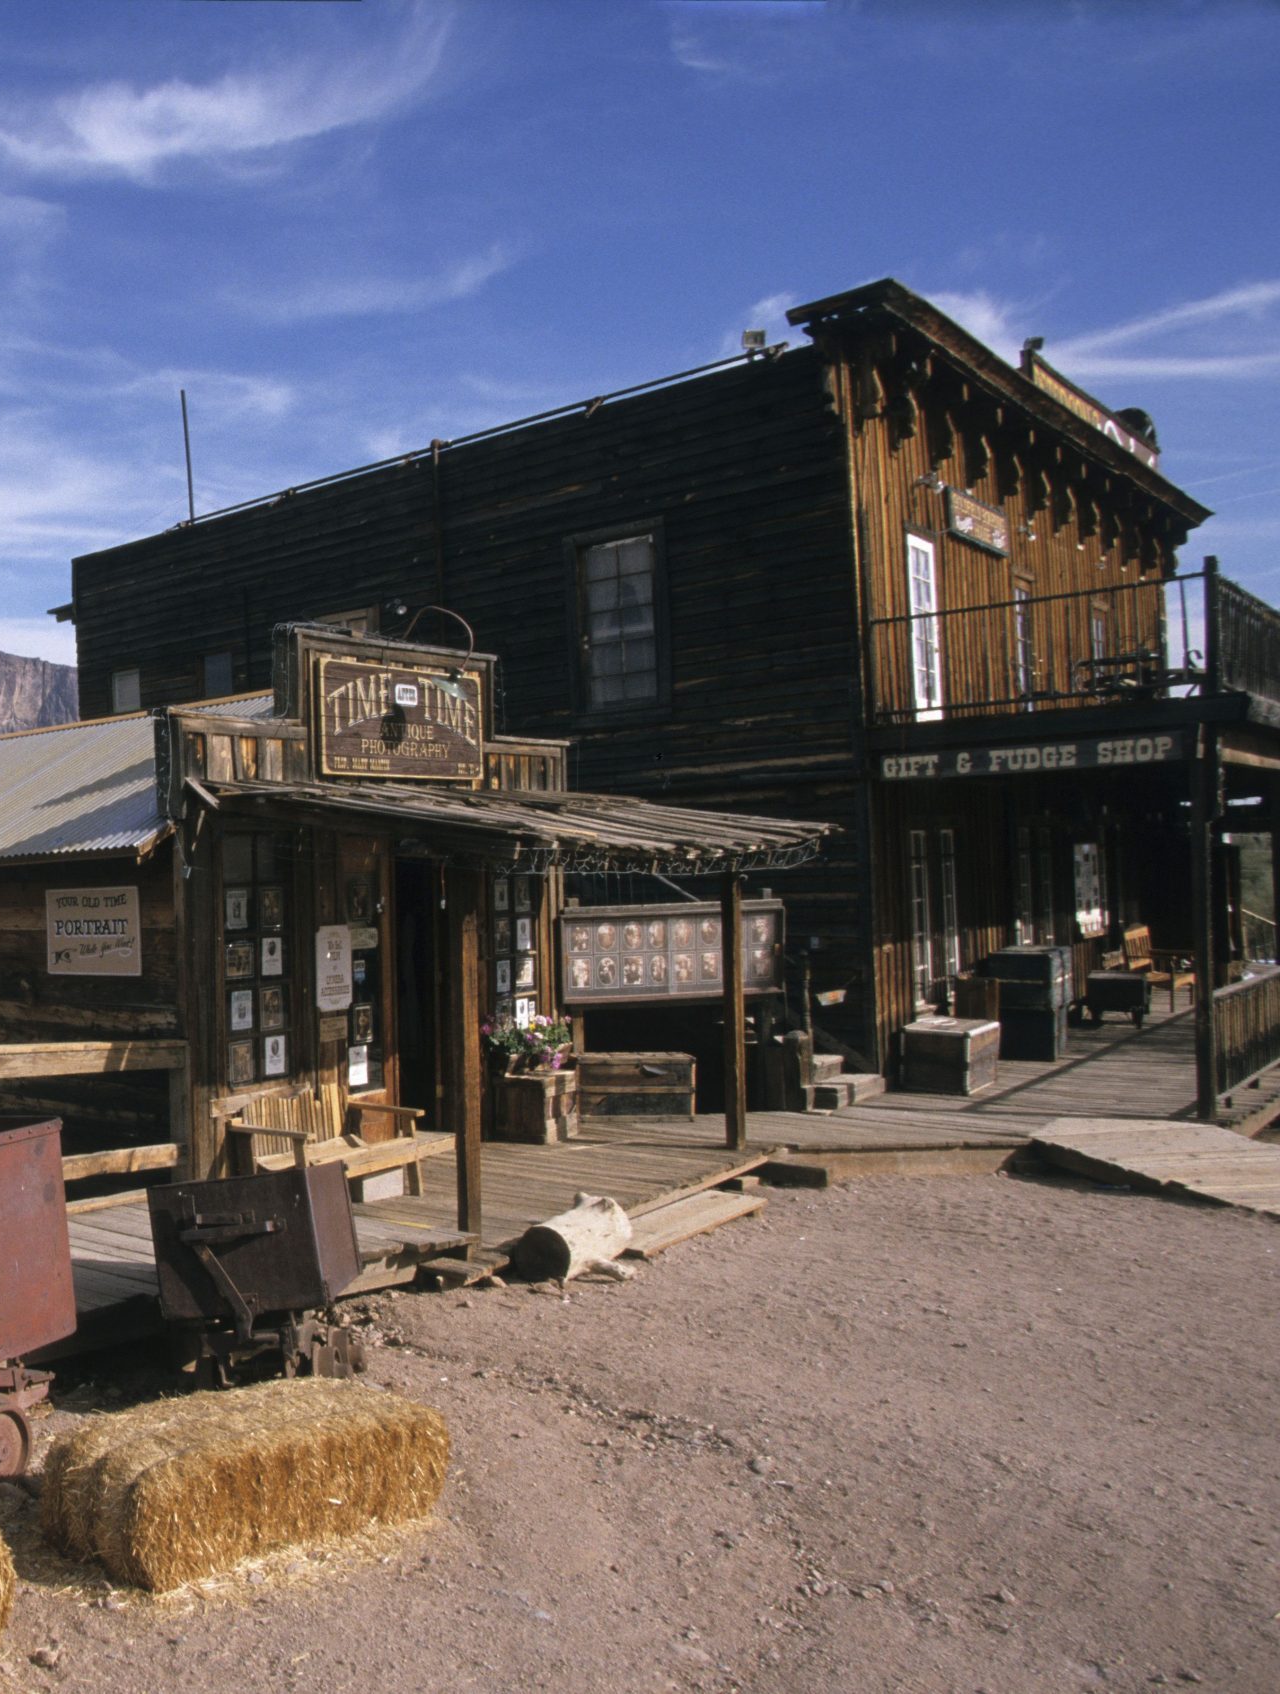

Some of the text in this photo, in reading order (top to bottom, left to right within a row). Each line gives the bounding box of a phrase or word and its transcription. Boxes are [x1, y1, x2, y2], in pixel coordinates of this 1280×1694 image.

[326, 672, 392, 736] TIME
[418, 676, 477, 746] TIME
[380, 722, 434, 741] ANTIQUE
[361, 738, 450, 759] PHOTOGRAPHY
[882, 736, 1172, 779] GIFT & FUDGE SHOP
[55, 893, 127, 908] YOUR OLD TIME
[55, 919, 128, 936] PORTRAIT
